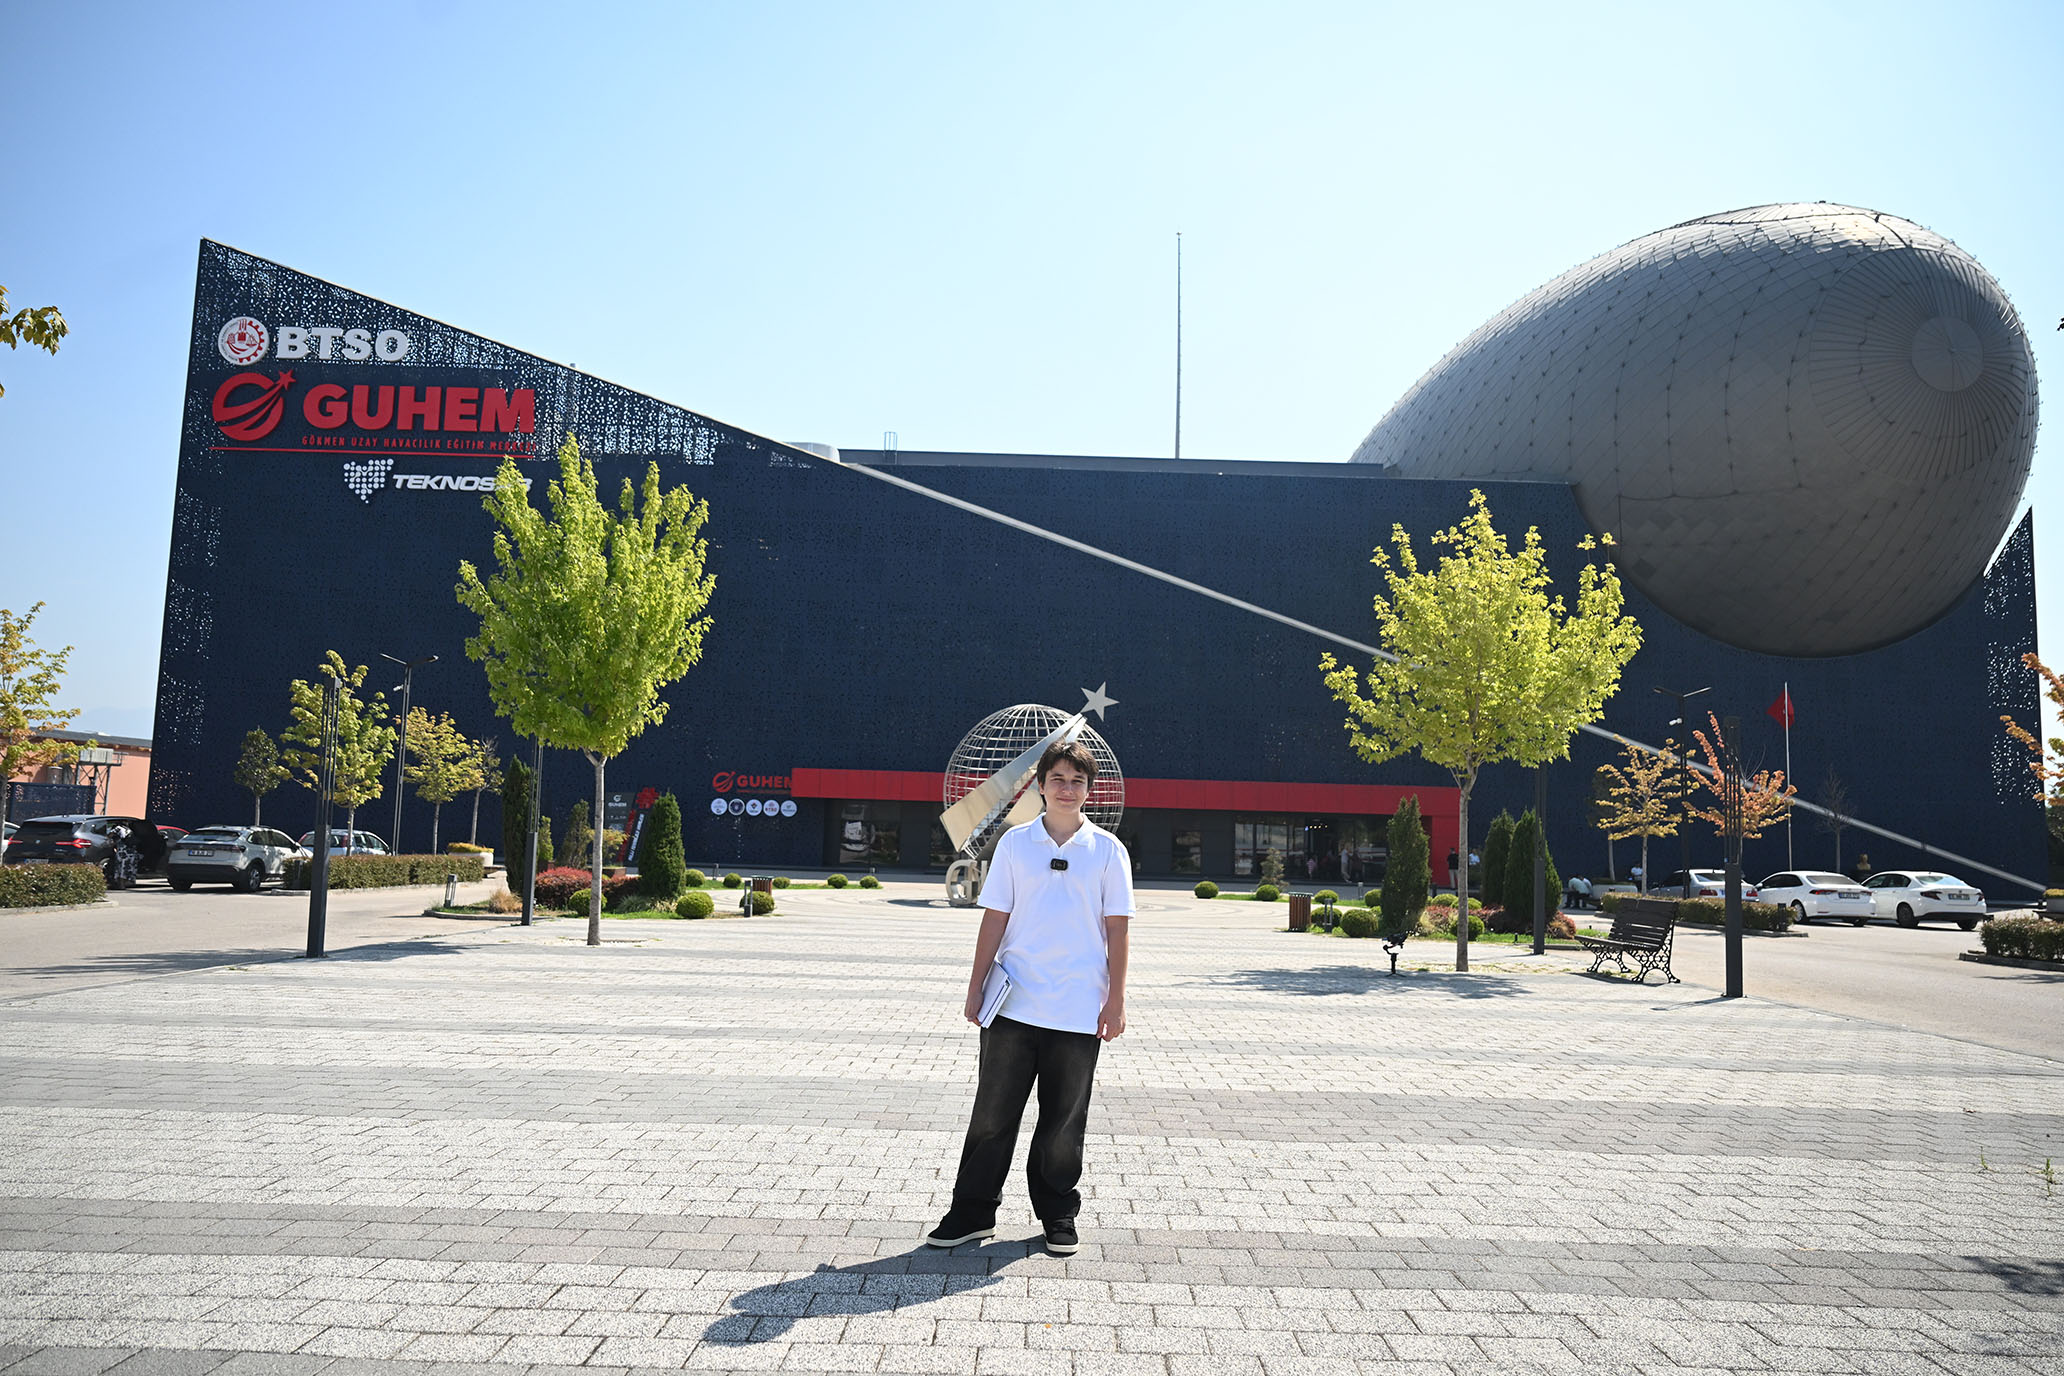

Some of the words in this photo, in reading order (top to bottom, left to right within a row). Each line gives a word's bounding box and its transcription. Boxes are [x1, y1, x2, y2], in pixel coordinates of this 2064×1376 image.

[276, 326, 410, 361] BTSO
[303, 383, 535, 433] GUHEM
[302, 434, 345, 446] GÖKMEN
[351, 437, 378, 447] UZAY
[384, 438, 441, 449] HAVACILIK
[392, 474, 533, 492] TEKNOSB
